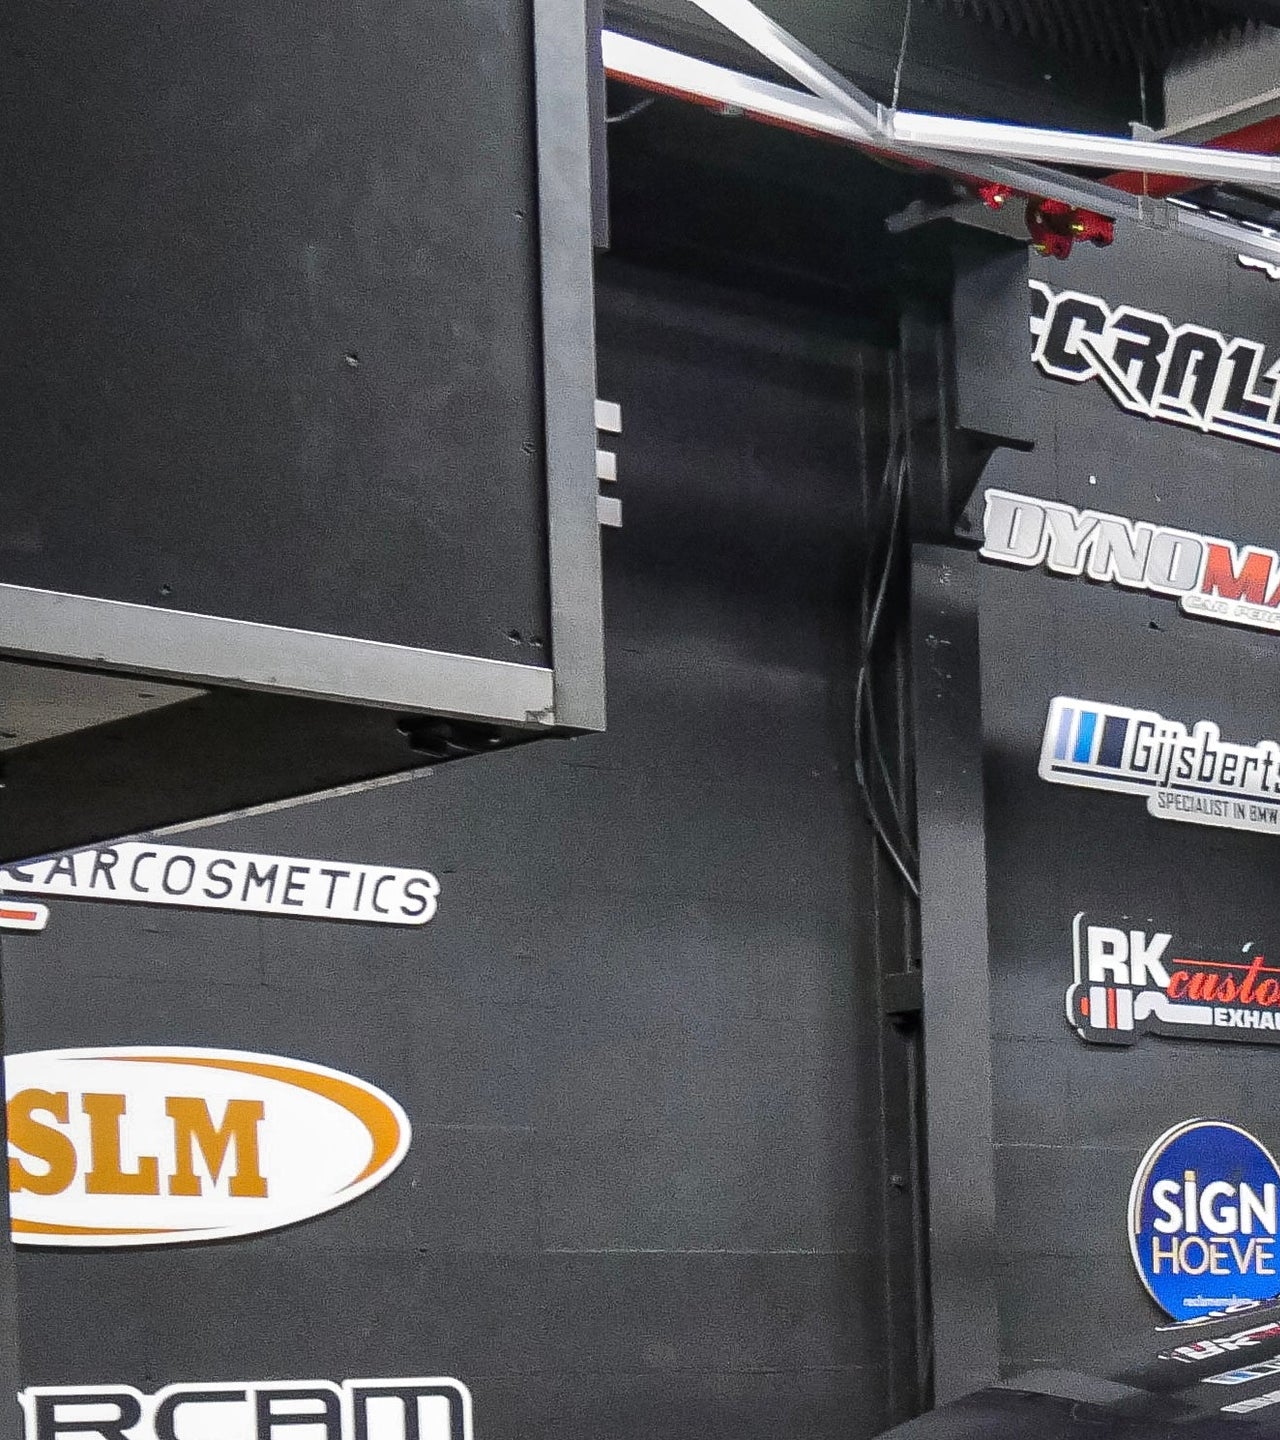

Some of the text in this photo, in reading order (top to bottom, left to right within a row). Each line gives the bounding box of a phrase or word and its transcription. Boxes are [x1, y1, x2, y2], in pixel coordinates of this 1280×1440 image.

[1157, 791, 1229, 819] SPECIALIST
[1233, 801, 1246, 821] IN
[1249, 803, 1278, 826] BMW
[1087, 925, 1173, 989] RK
[7, 1088, 268, 1198] SLM
[1152, 1235, 1277, 1276] HOEVE
